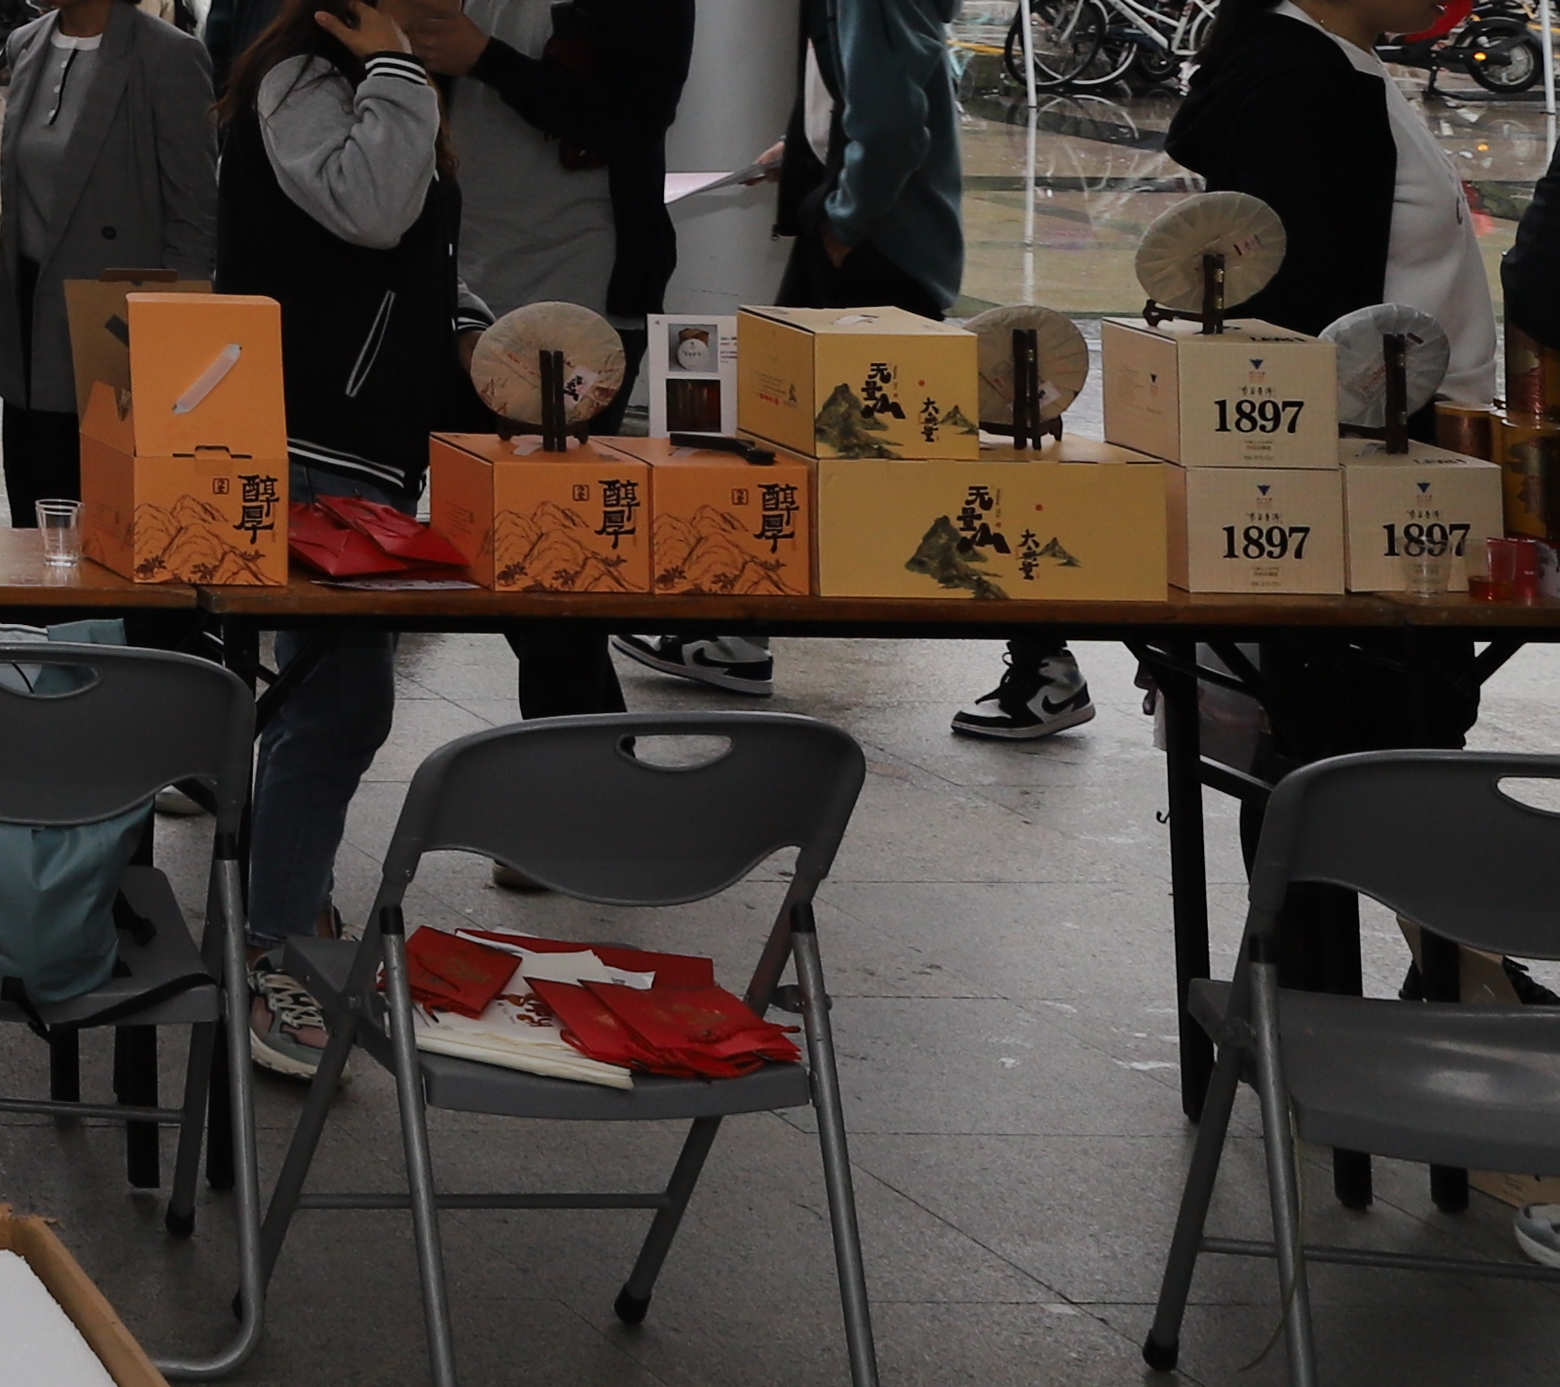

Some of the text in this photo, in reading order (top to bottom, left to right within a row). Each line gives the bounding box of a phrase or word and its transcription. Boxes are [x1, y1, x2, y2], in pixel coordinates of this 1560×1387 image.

[860, 362, 906, 420] 无量山
[1213, 398, 1305, 435] 1897
[232, 474, 280, 545] 醇厚
[594, 479, 641, 550] 醇厚
[754, 482, 800, 554] 醇厚
[956, 485, 1012, 554] 无量山
[1382, 521, 1471, 558] 1897
[1222, 524, 1311, 560] 1897
